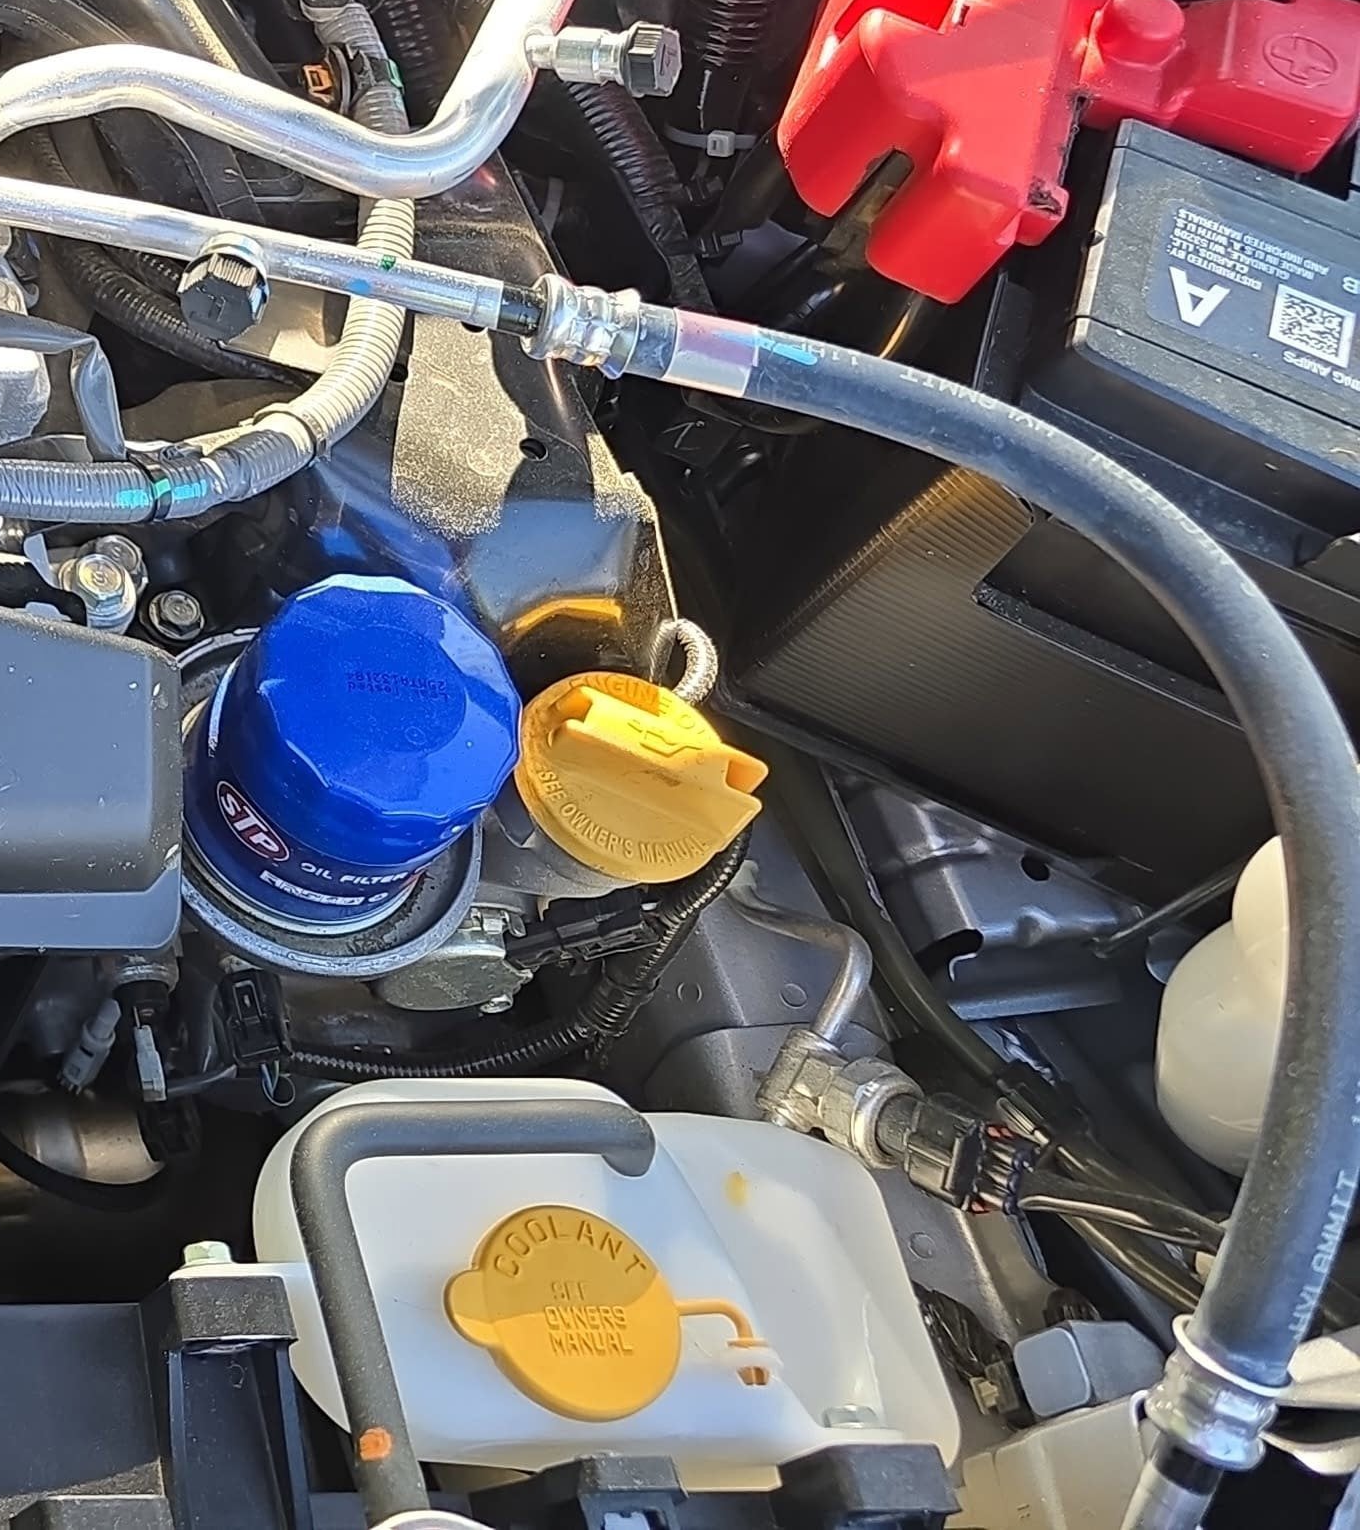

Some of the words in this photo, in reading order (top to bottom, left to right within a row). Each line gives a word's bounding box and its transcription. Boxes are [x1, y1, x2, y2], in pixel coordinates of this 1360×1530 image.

[1178, 208, 1243, 240] MATERIALS
[1197, 227, 1229, 245] WITH
[1243, 234, 1303, 263] IMPORTED
[1186, 253, 1263, 290] DISTRIBUTED
[1169, 265, 1232, 328] A
[1281, 350, 1332, 377] AMPS
[220, 793, 280, 853] STP
[538, 770, 568, 803] SEE
[561, 801, 634, 858] OWNER'S
[637, 833, 710, 864] MANUAL
[300, 862, 333, 880] OIL
[340, 871, 409, 885] FILTER
[493, 1214, 648, 1279] COOLANT
[551, 1280, 590, 1301] SEE
[543, 1304, 627, 1330] OWNERS
[548, 1331, 633, 1357] MANUAL
